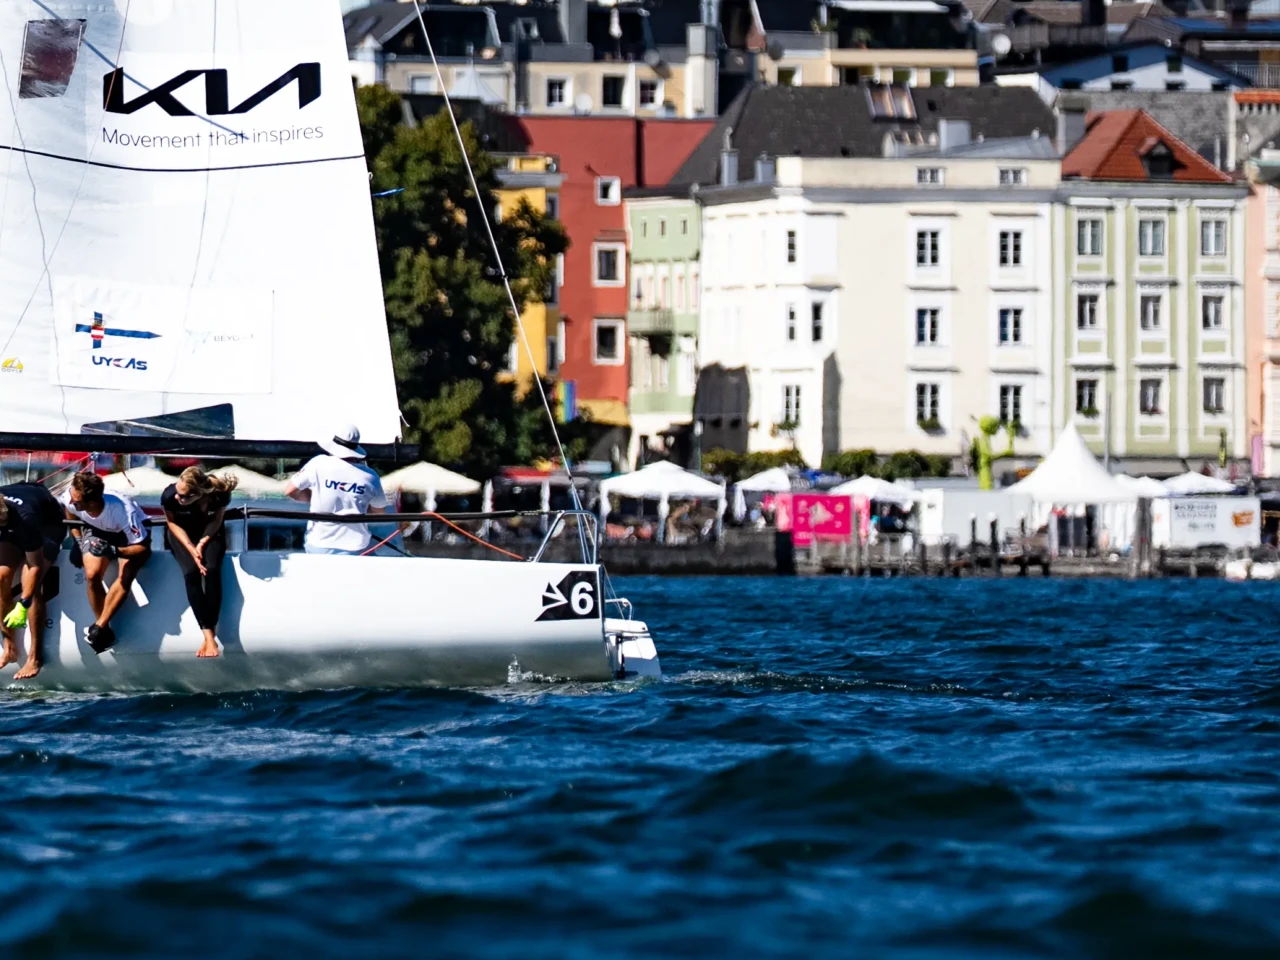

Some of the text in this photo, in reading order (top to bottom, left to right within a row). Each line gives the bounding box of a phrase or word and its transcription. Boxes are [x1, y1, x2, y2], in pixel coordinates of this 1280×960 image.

[103, 62, 321, 116] KIA
[102, 125, 324, 148] Movement that inspires
[570, 581, 594, 616] 6
